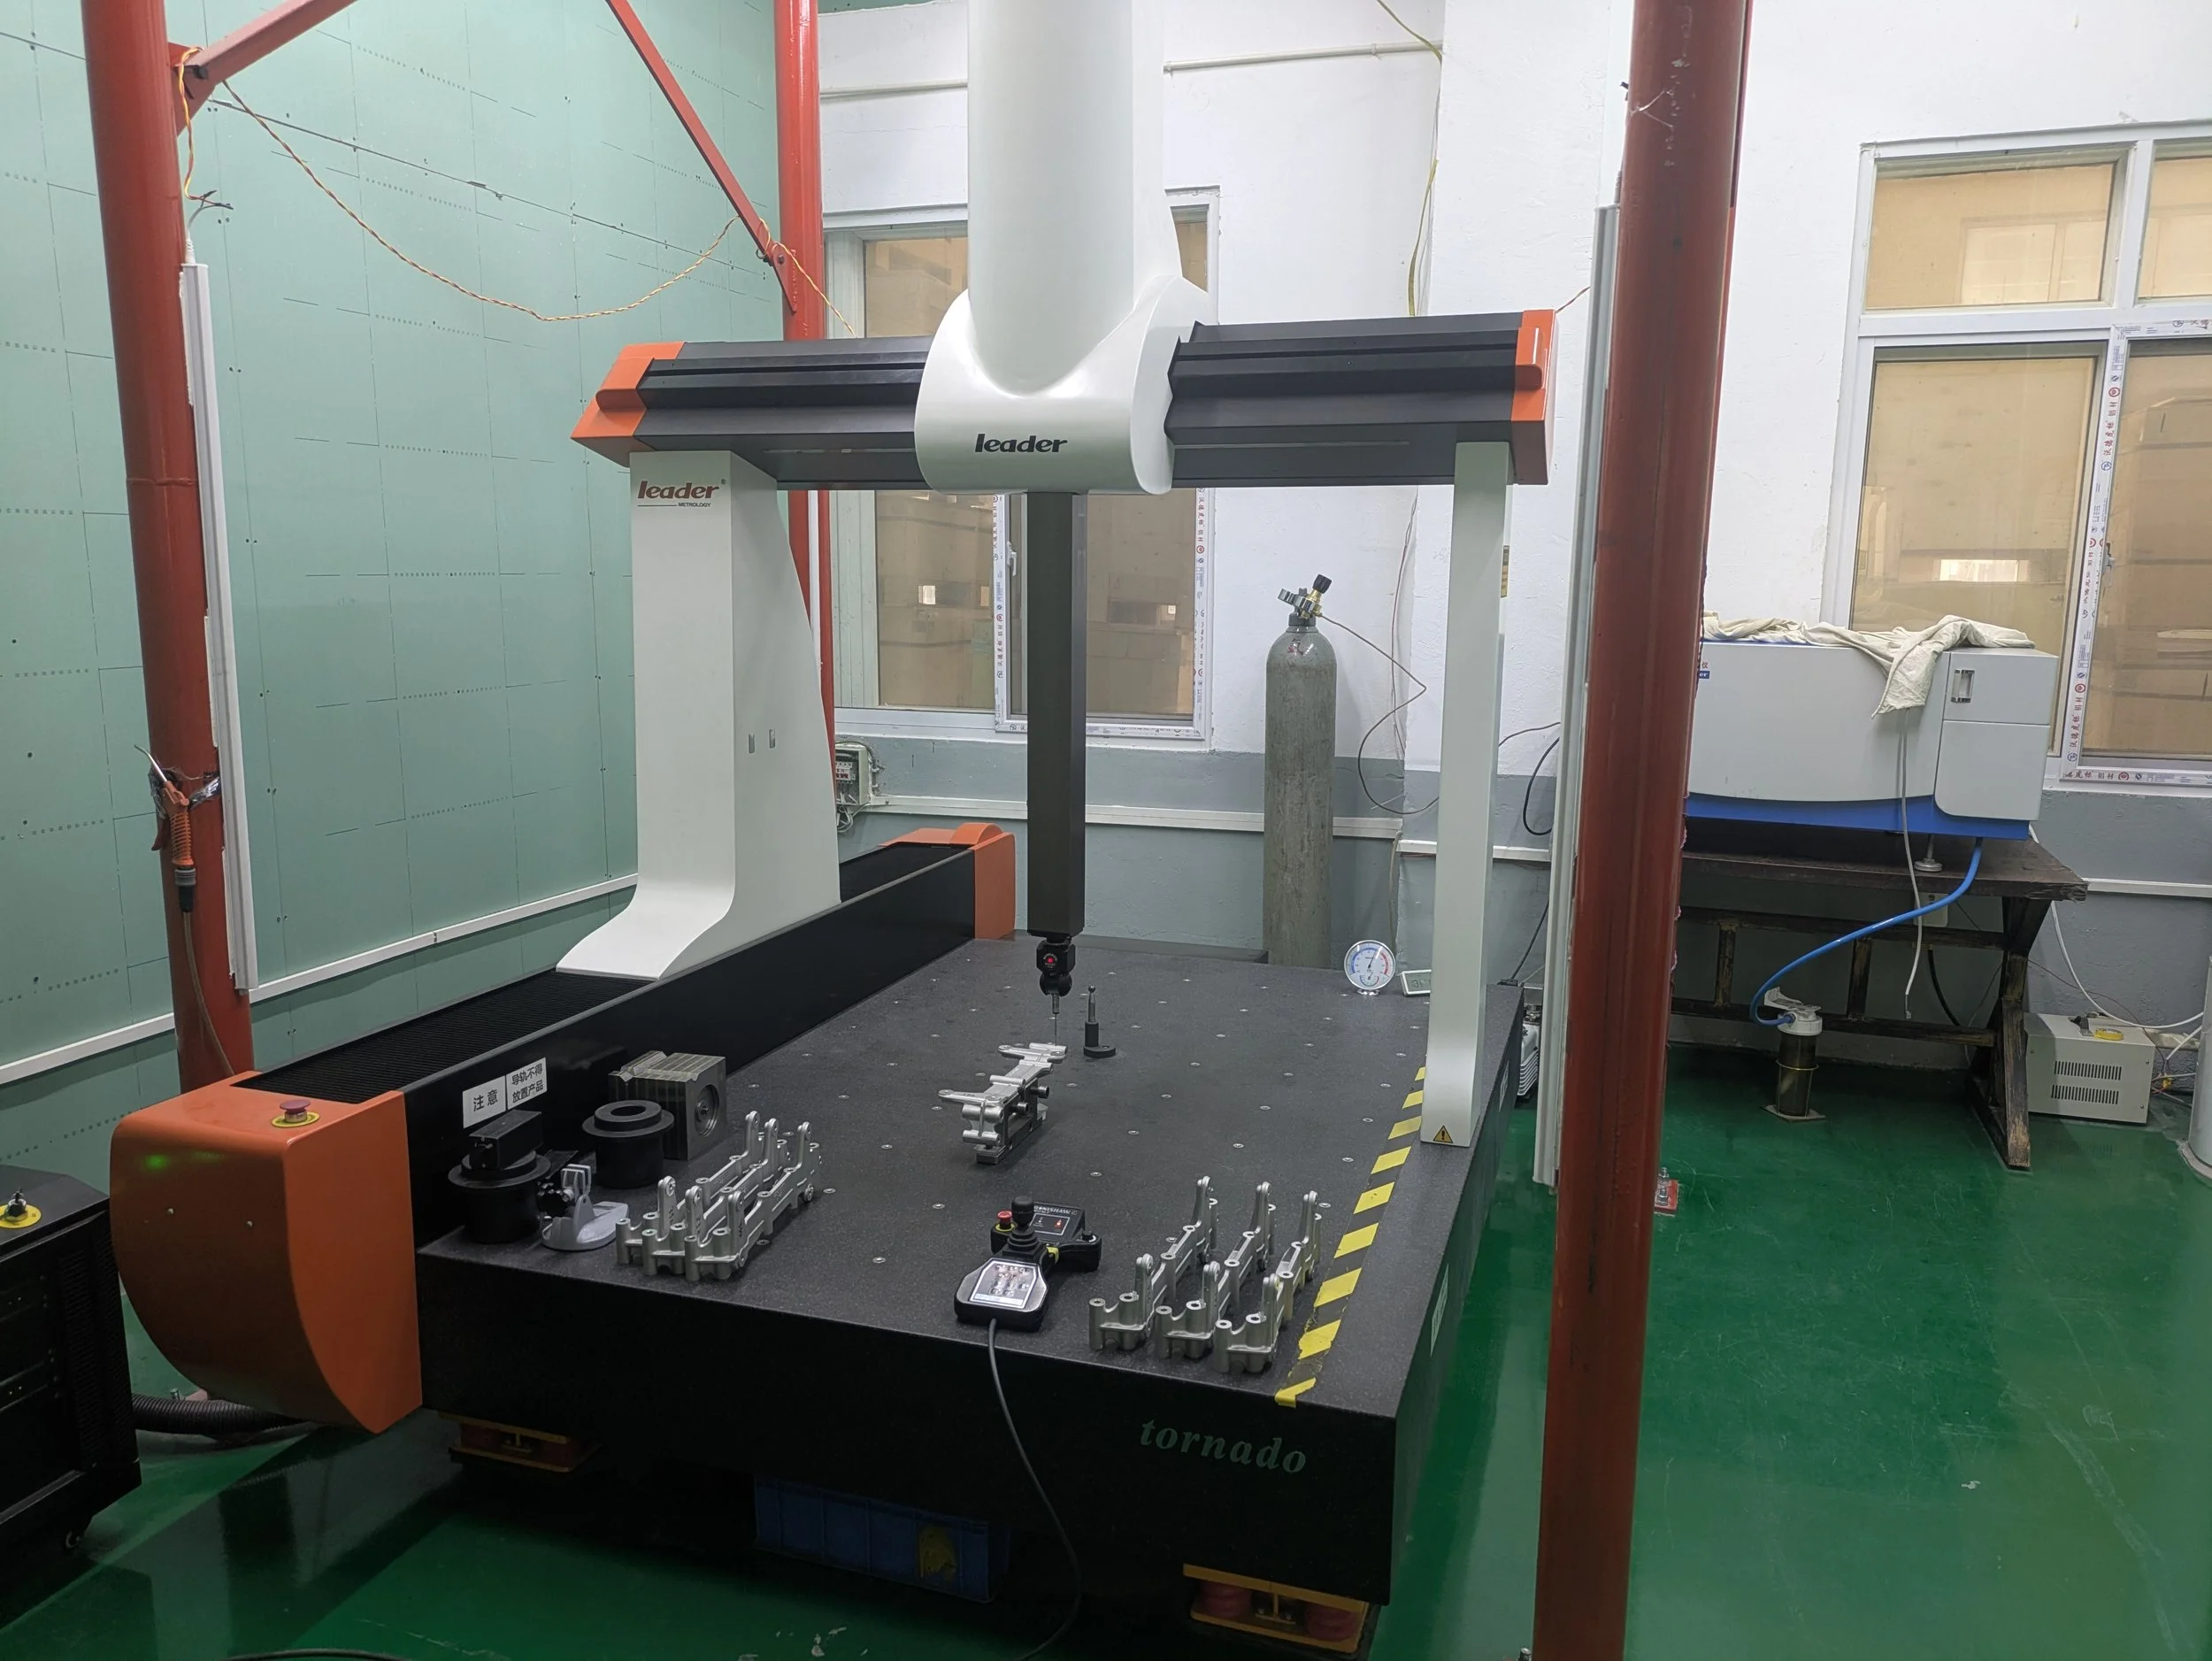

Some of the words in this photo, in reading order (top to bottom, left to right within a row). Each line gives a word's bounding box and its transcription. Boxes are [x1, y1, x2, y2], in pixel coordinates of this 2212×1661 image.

[974, 433, 1068, 453] leader
[637, 481, 720, 499] leader
[511, 1063, 542, 1086] 导轨不得
[472, 1088, 498, 1112] 注意
[512, 1079, 544, 1103] 放置产品
[1140, 1419, 1307, 1473] tornado
